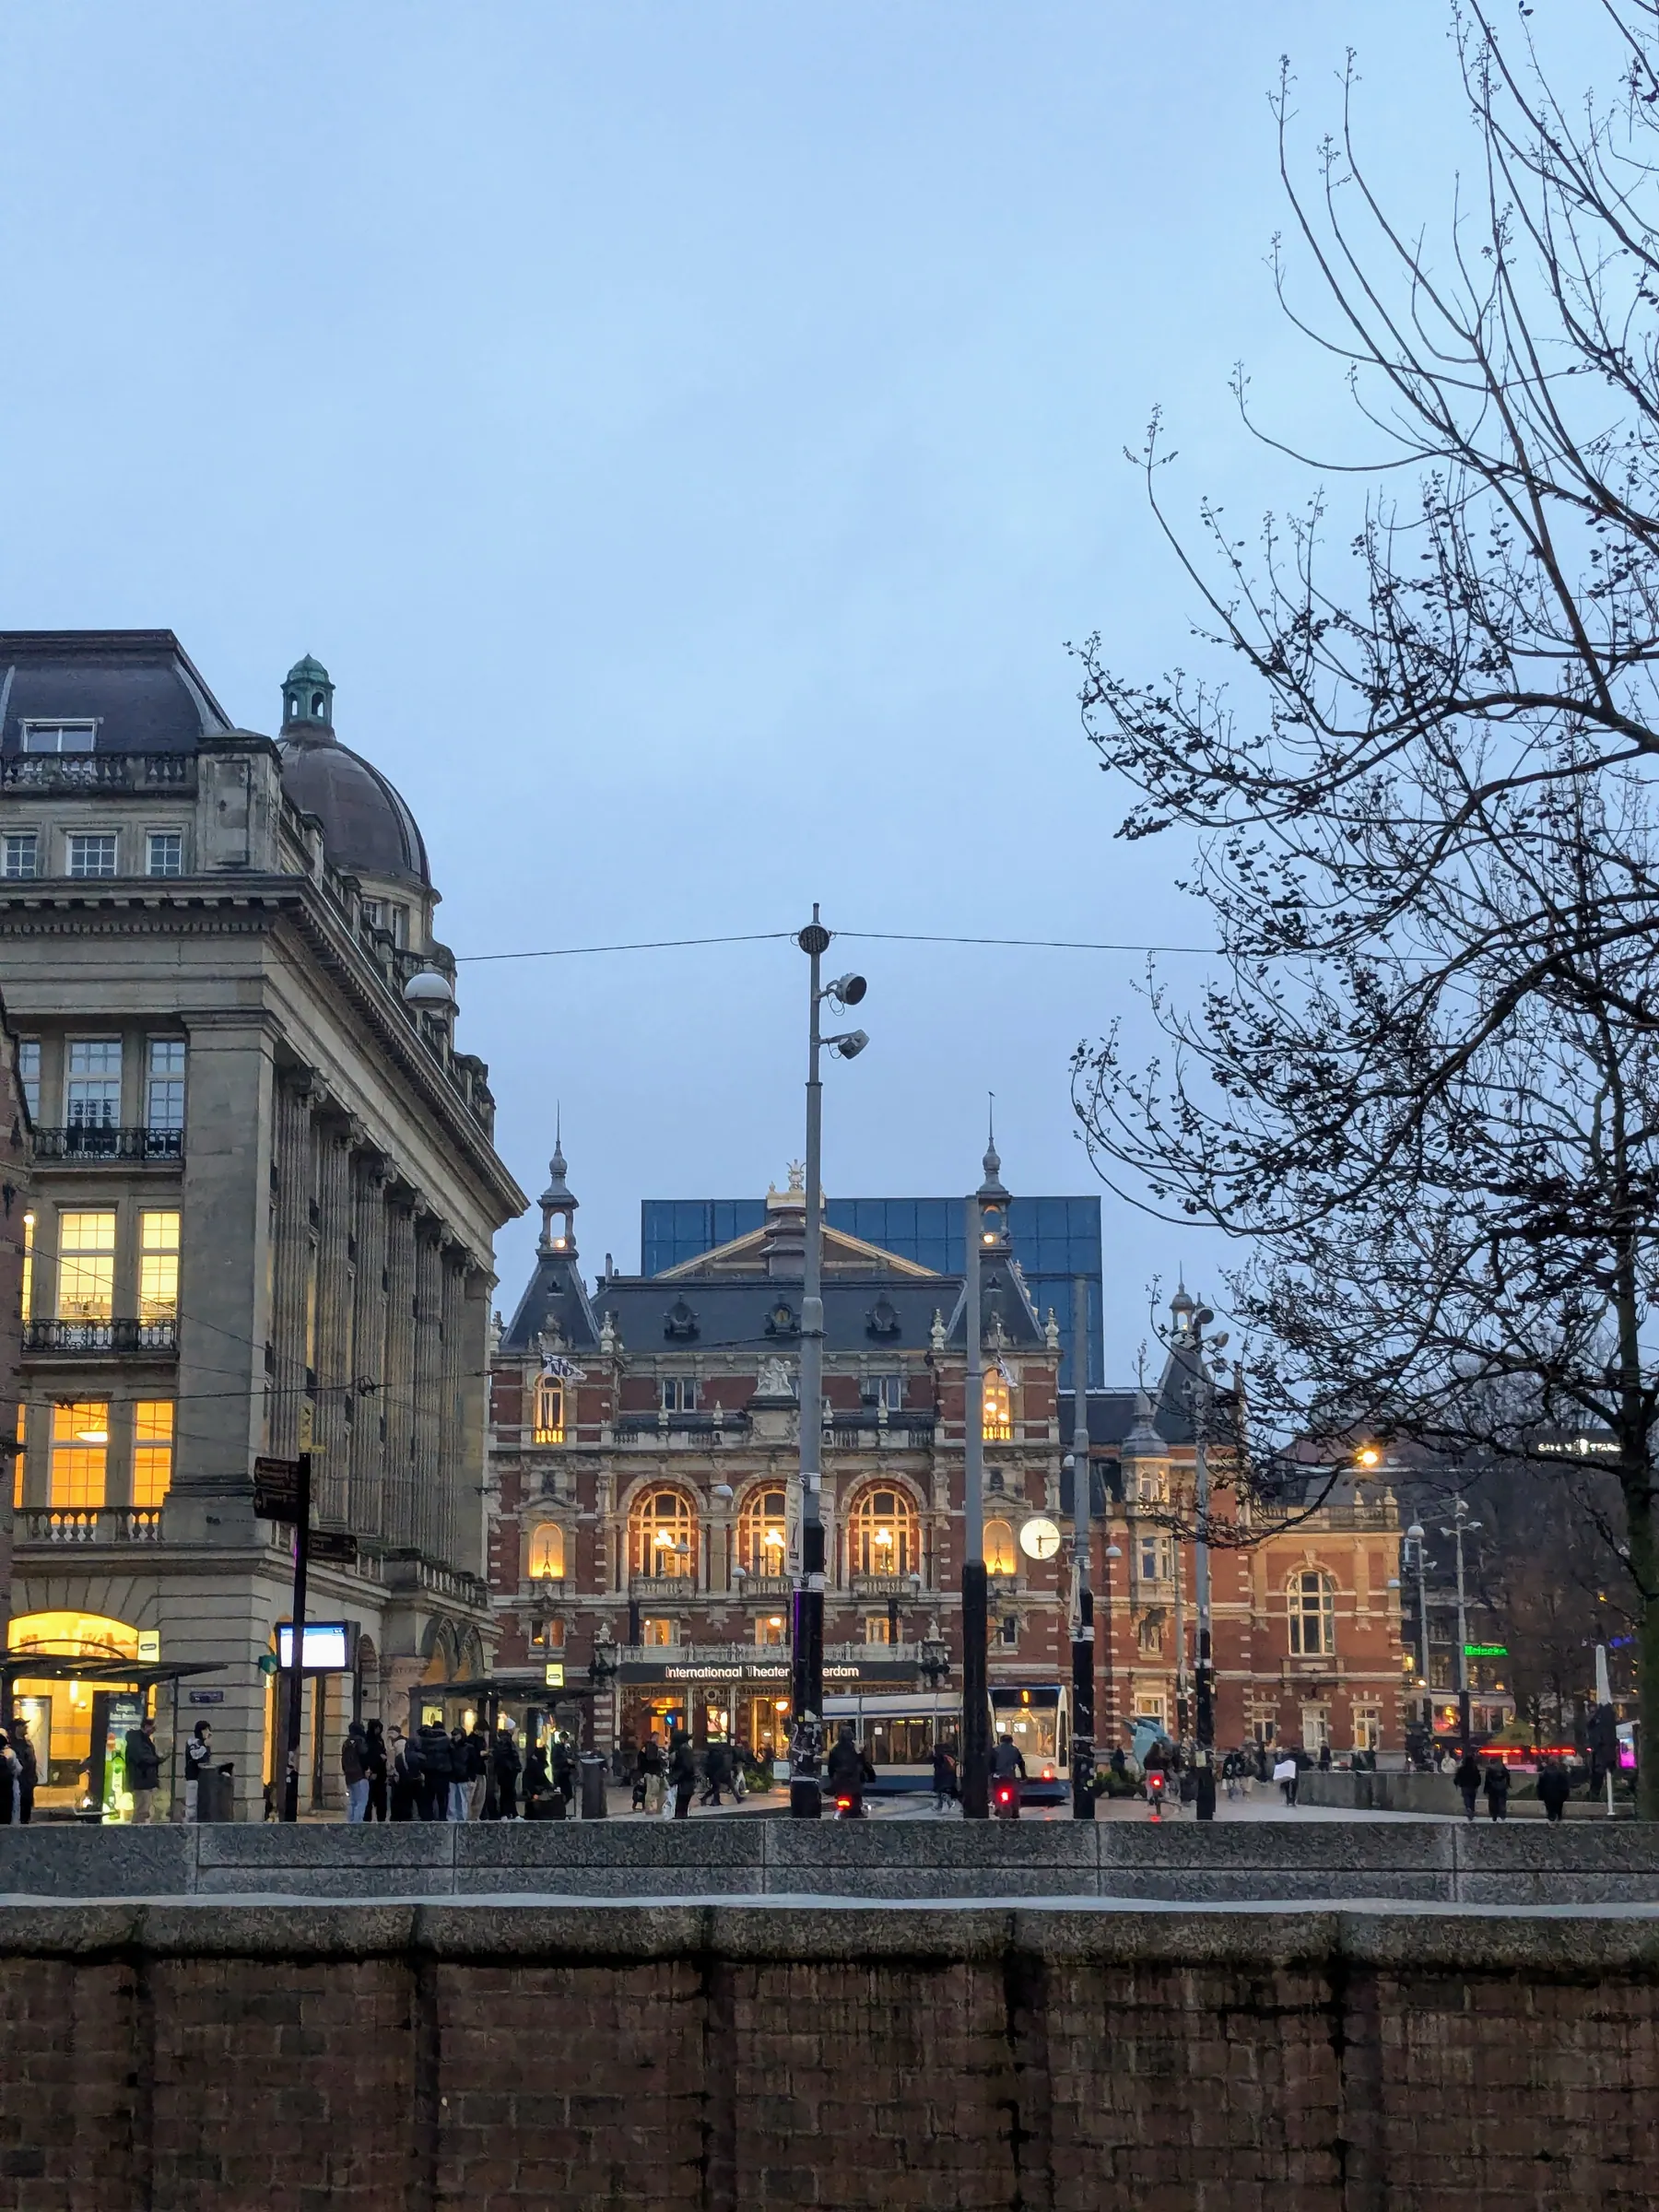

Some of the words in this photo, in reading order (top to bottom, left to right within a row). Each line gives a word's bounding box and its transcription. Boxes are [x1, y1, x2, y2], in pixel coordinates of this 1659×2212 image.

[665, 1665, 742, 1678] Internationaal
[746, 1665, 790, 1677] Theater
[822, 1665, 859, 1677] erdam
